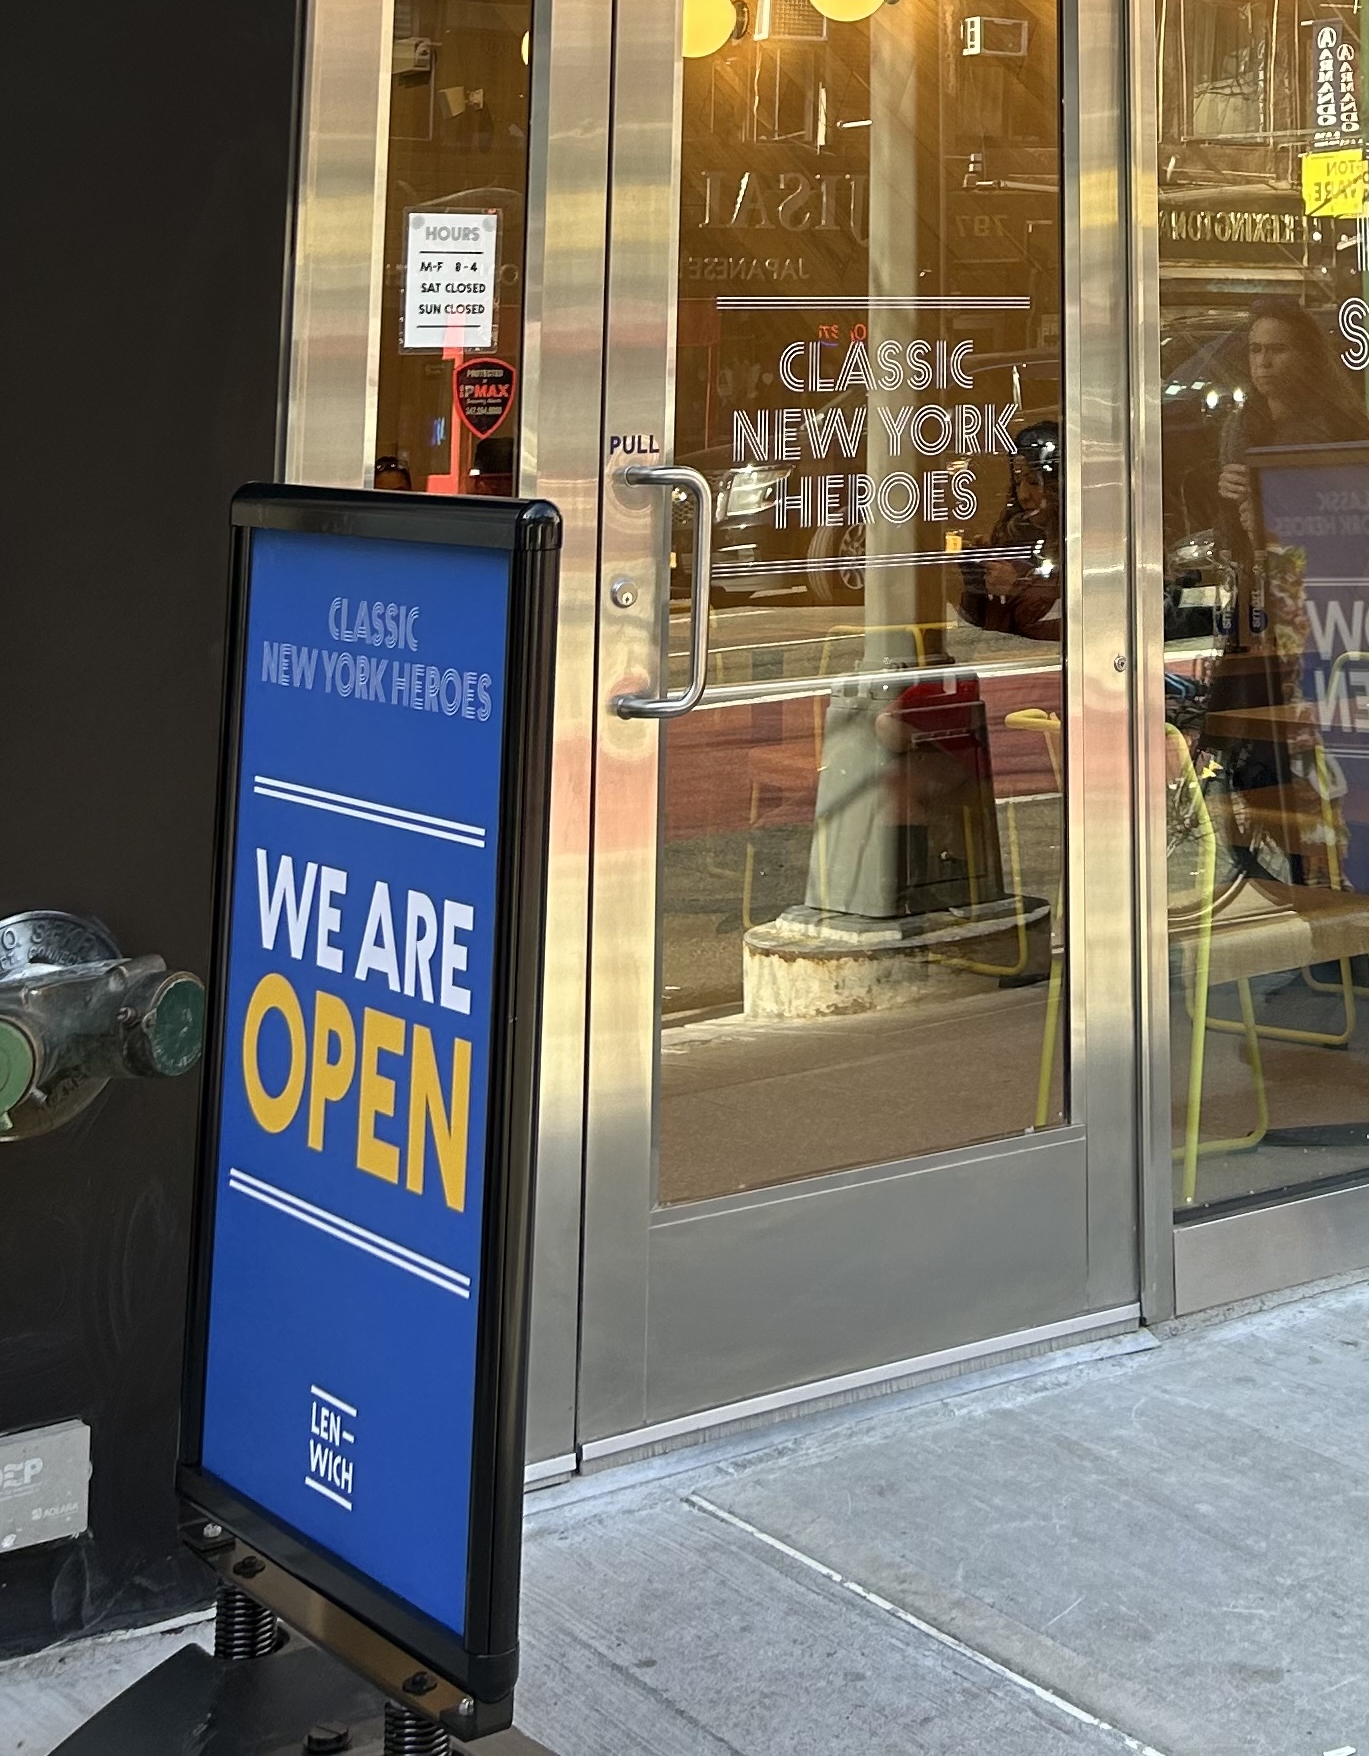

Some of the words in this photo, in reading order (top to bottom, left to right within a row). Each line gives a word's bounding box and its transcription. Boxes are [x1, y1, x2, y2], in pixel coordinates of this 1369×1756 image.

[425, 225, 481, 242] HOURS
[420, 261, 444, 273] M-F
[420, 282, 442, 294] SAT
[444, 282, 486, 294] CLOSED
[418, 303, 441, 315] SUN
[444, 303, 485, 315] CLOSED
[779, 339, 975, 393] CLASSIC
[609, 435, 660, 455] PULL
[732, 405, 867, 462] NEW
[876, 403, 1018, 457] YORK
[774, 469, 978, 529] HEROES
[328, 596, 420, 652] CLASSIC
[261, 642, 316, 691] NEW
[322, 650, 388, 706] YORK
[393, 661, 493, 723] HEROES
[255, 847, 348, 975] WE
[354, 881, 474, 1015] ARE
[242, 972, 472, 1215] OPEN
[0, 1457, 44, 1491] EP
[308, 1436, 354, 1495] WICH
